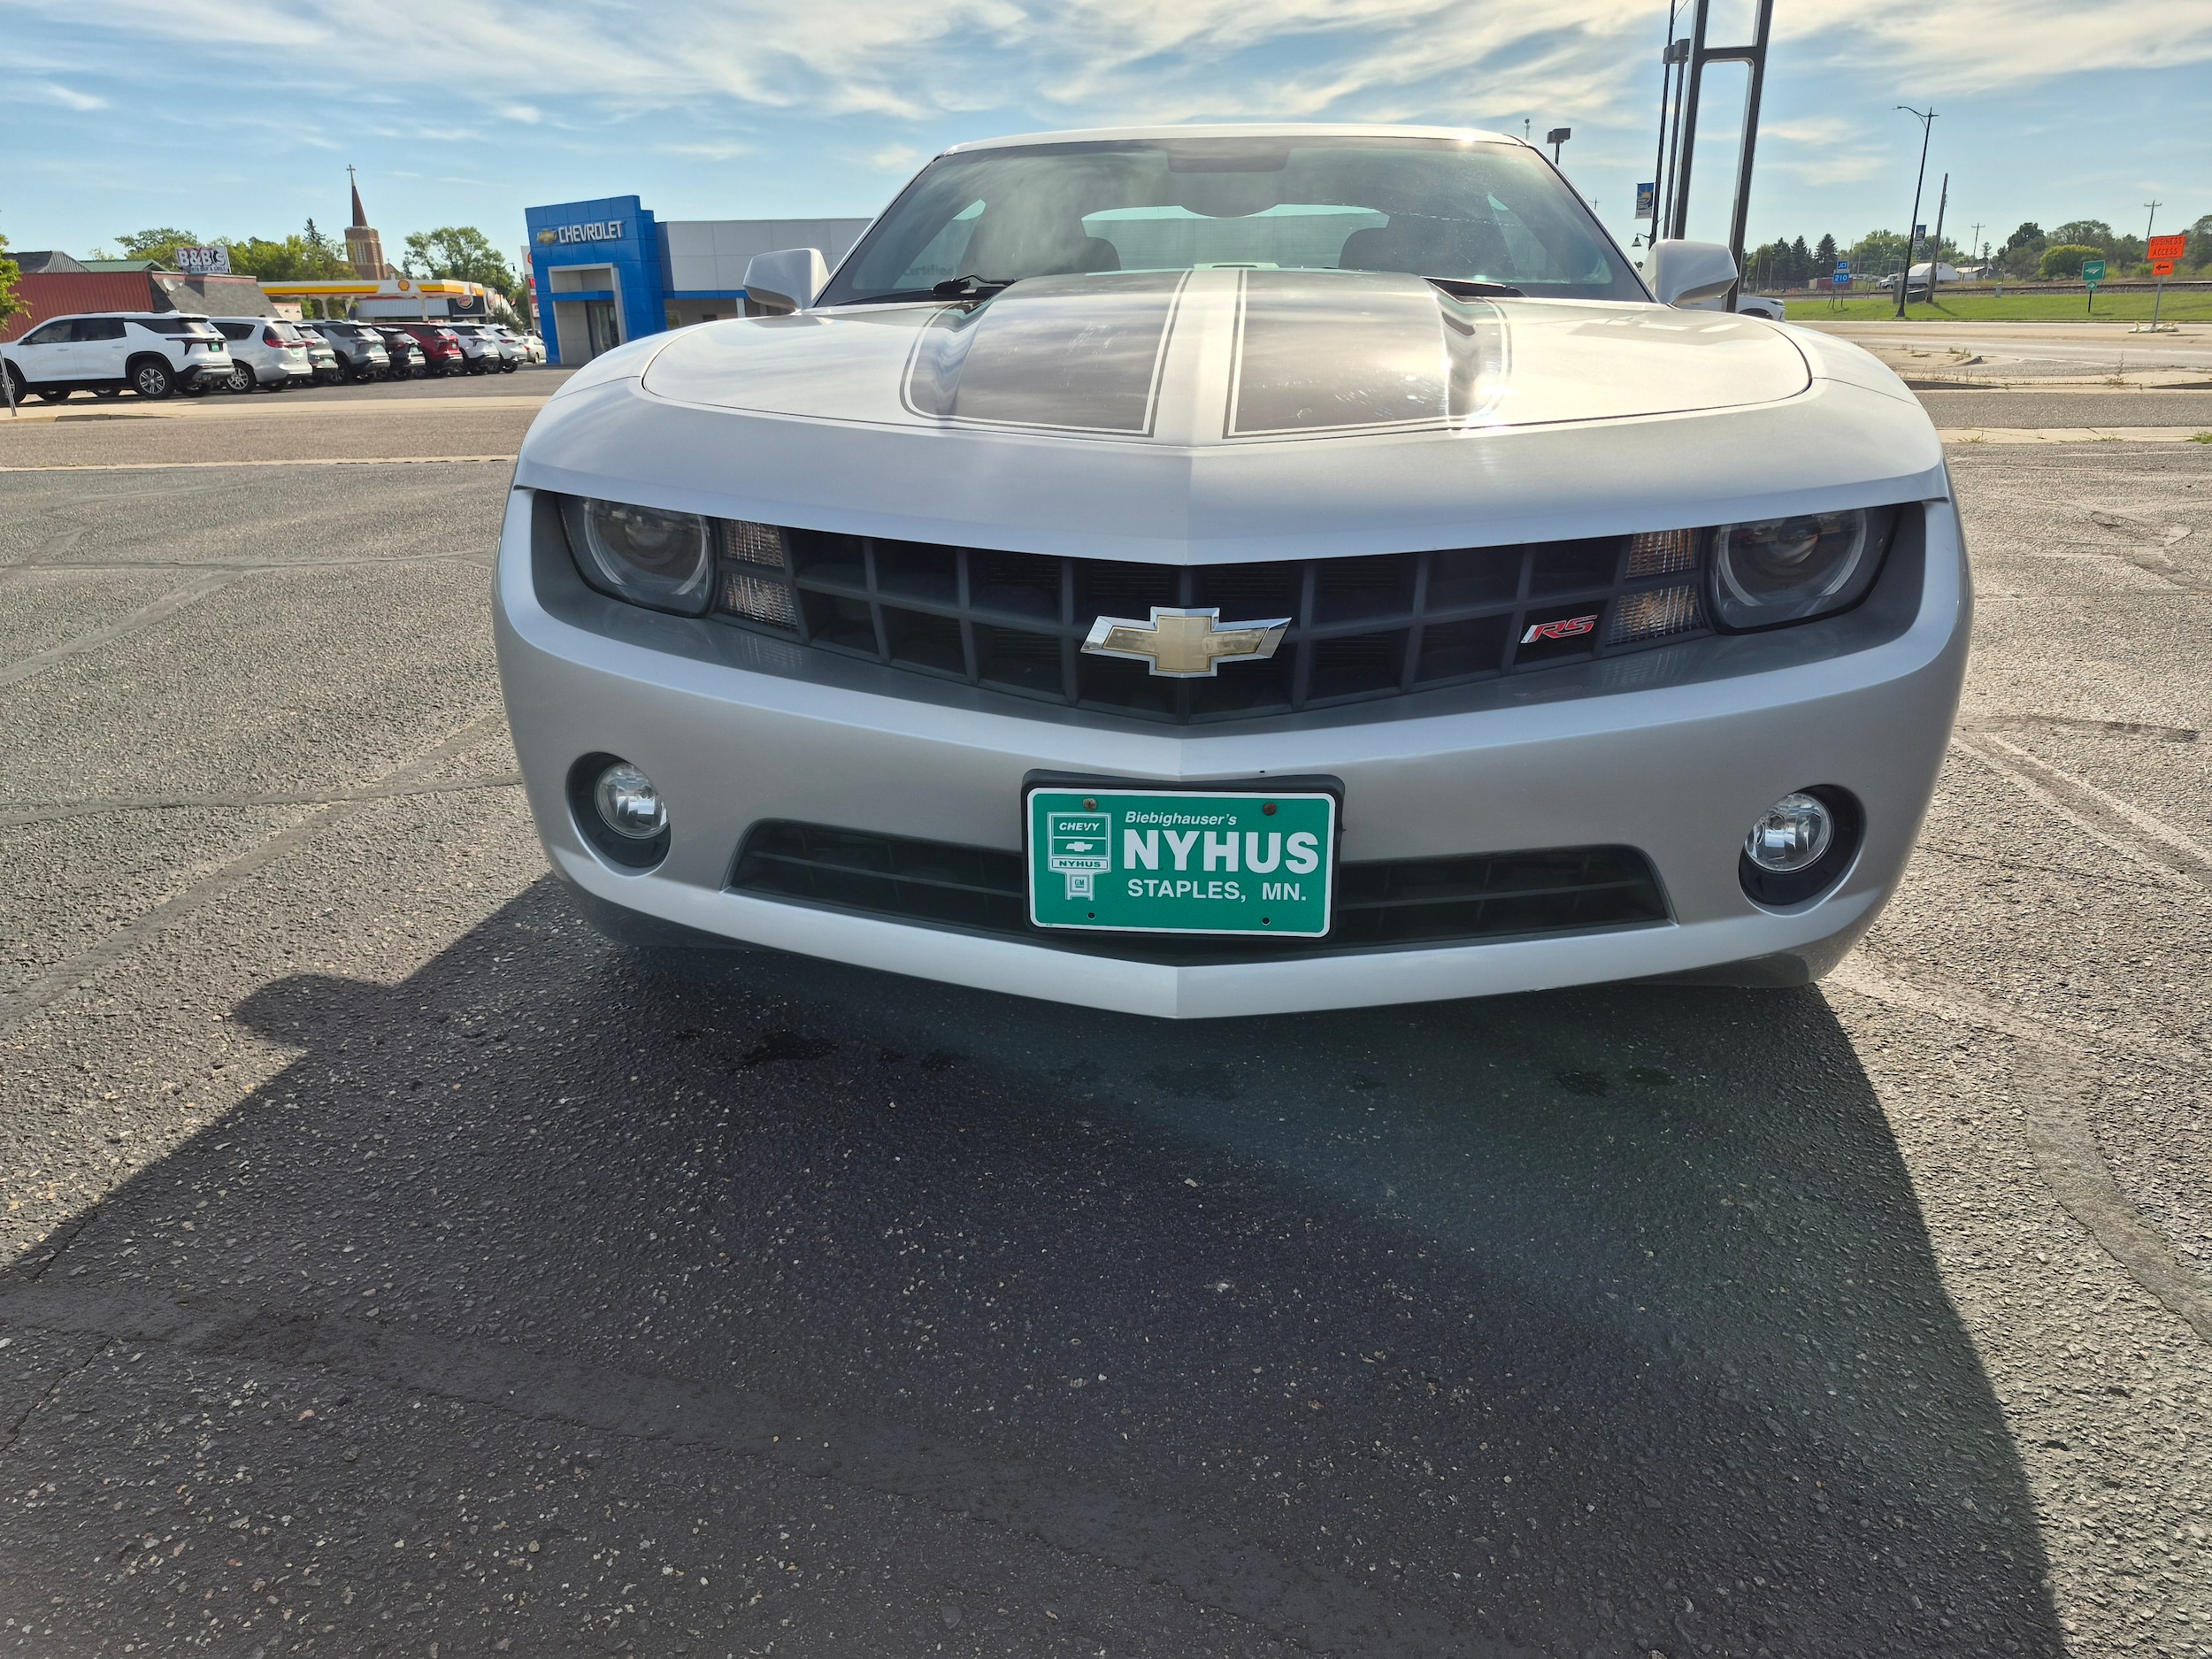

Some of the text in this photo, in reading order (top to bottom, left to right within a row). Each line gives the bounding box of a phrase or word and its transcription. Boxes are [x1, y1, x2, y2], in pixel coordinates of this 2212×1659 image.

[557, 221, 622, 243] CHEVROLET
[2151, 236, 2183, 246] BUSINESS
[2152, 248, 2178, 257] ACCESS
[1521, 615, 1598, 643] RS
[1059, 822, 1100, 831] CHEVY
[1125, 810, 1237, 826] Biebighauser's
[1124, 829, 1319, 874] NYHUS
[1127, 879, 1307, 903] STAPLES, MN.
